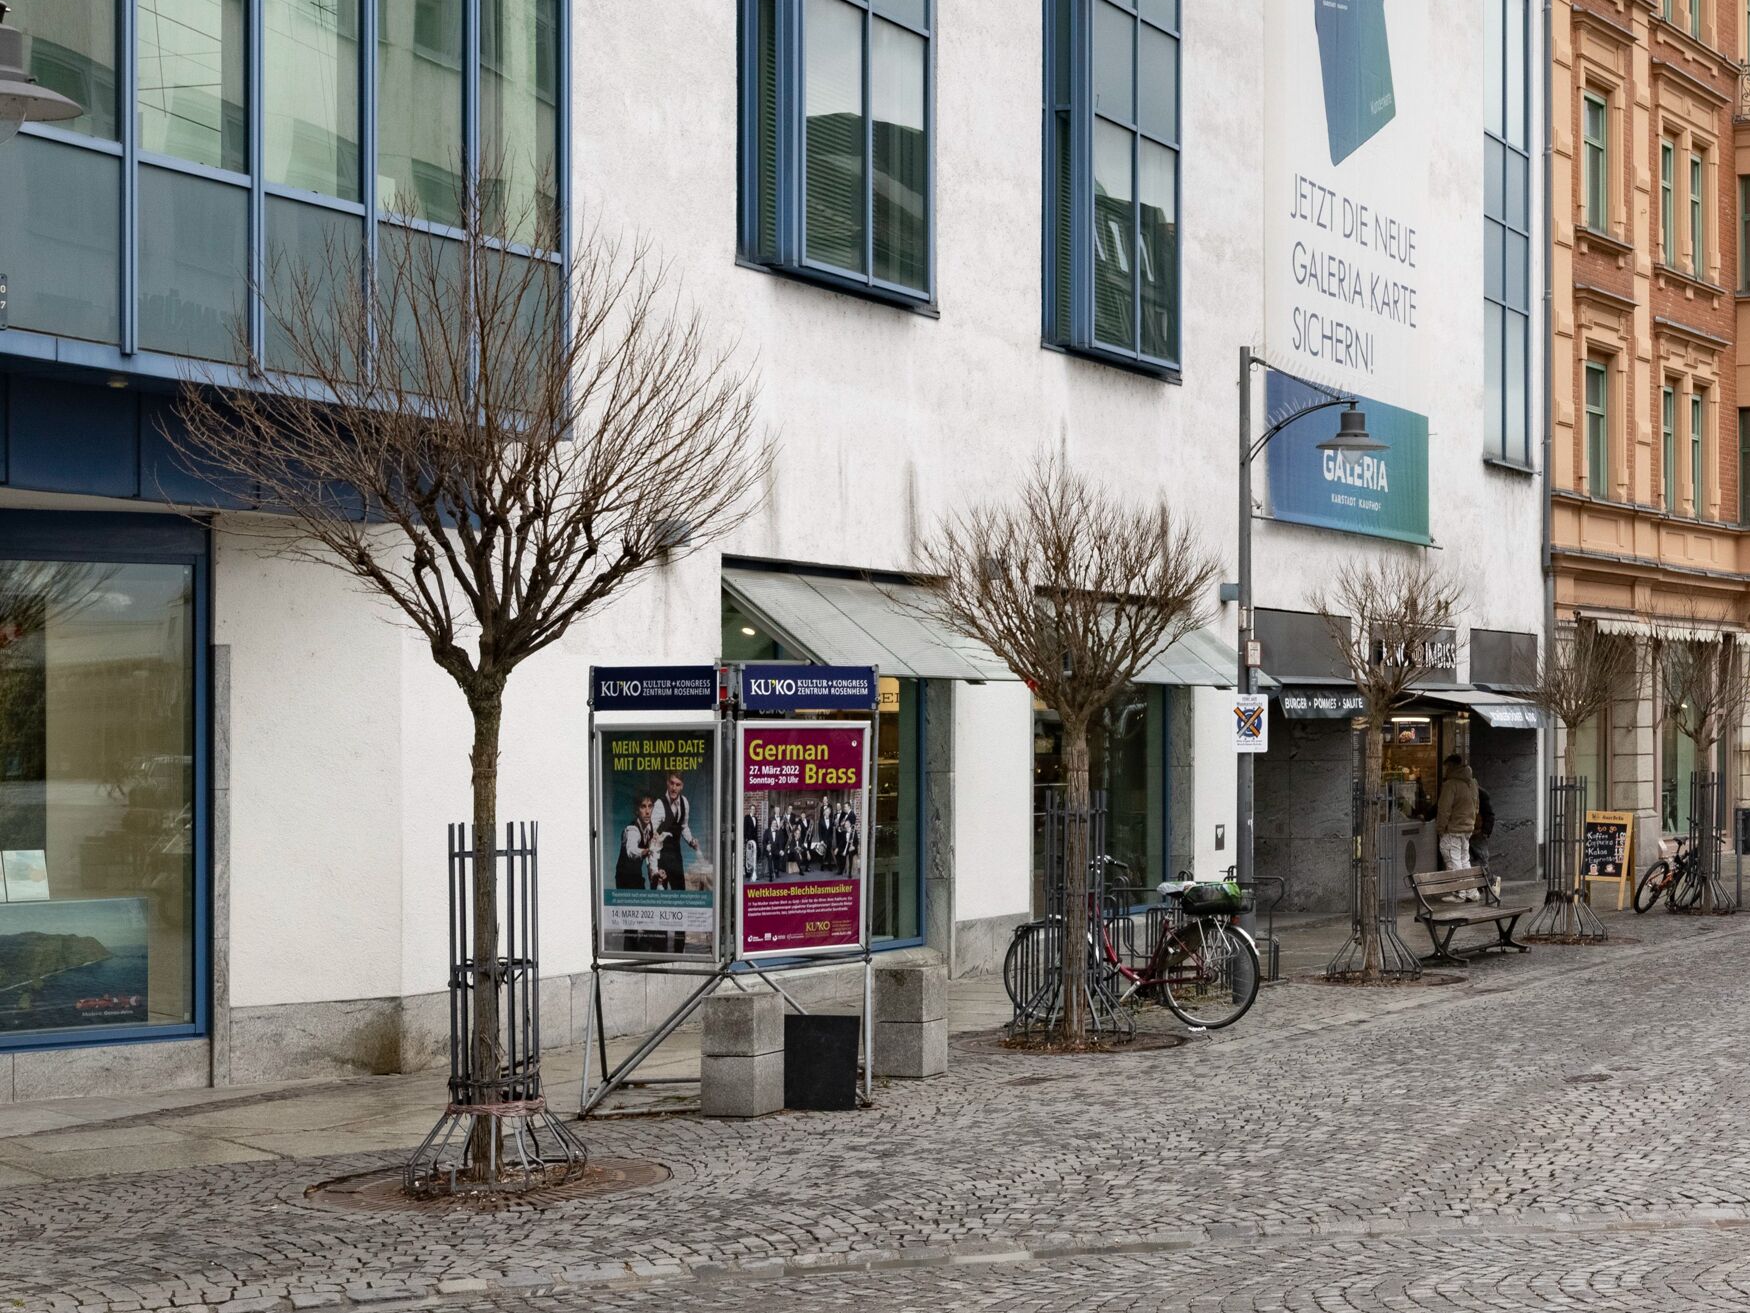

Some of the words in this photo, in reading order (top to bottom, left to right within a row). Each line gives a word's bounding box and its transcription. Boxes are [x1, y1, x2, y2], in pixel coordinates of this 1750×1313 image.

[1290, 173, 1336, 233] JETZT
[1342, 197, 1368, 247] DIE
[1375, 211, 1416, 268] NEUE
[1292, 240, 1364, 309] GALERIA
[1370, 271, 1417, 329] KARTE
[1292, 306, 1374, 375] SICHERN!
[1322, 449, 1389, 493] GALERIA
[1331, 493, 1357, 507] KARSTADT
[1358, 497, 1382, 511] KAUFHOF
[601, 681, 641, 696] KU'KO
[643, 688, 672, 696] ZENTRUM
[674, 687, 711, 695] ROSENHEIM
[750, 679, 795, 695] KU'KO
[797, 687, 828, 695] ZENTRUM
[831, 687, 868, 695] ROSENHEIM
[1284, 698, 1307, 709] BURGER
[1314, 698, 1337, 709] POMMES
[612, 741, 640, 754] MEIN
[643, 740, 675, 754] BLIND
[678, 740, 705, 753] DATE
[749, 739, 828, 761] German
[614, 757, 634, 771] MIT
[637, 757, 661, 770] DEM
[749, 766, 760, 775] 27.
[762, 765, 780, 775] März
[782, 765, 800, 775] 2022
[749, 776, 775, 786] Sonntag
[778, 776, 786, 784] 20
[787, 776, 799, 784] Uhr
[805, 763, 856, 784] Brass
[747, 884, 852, 898] Weltklasse-Blechblasmusiker
